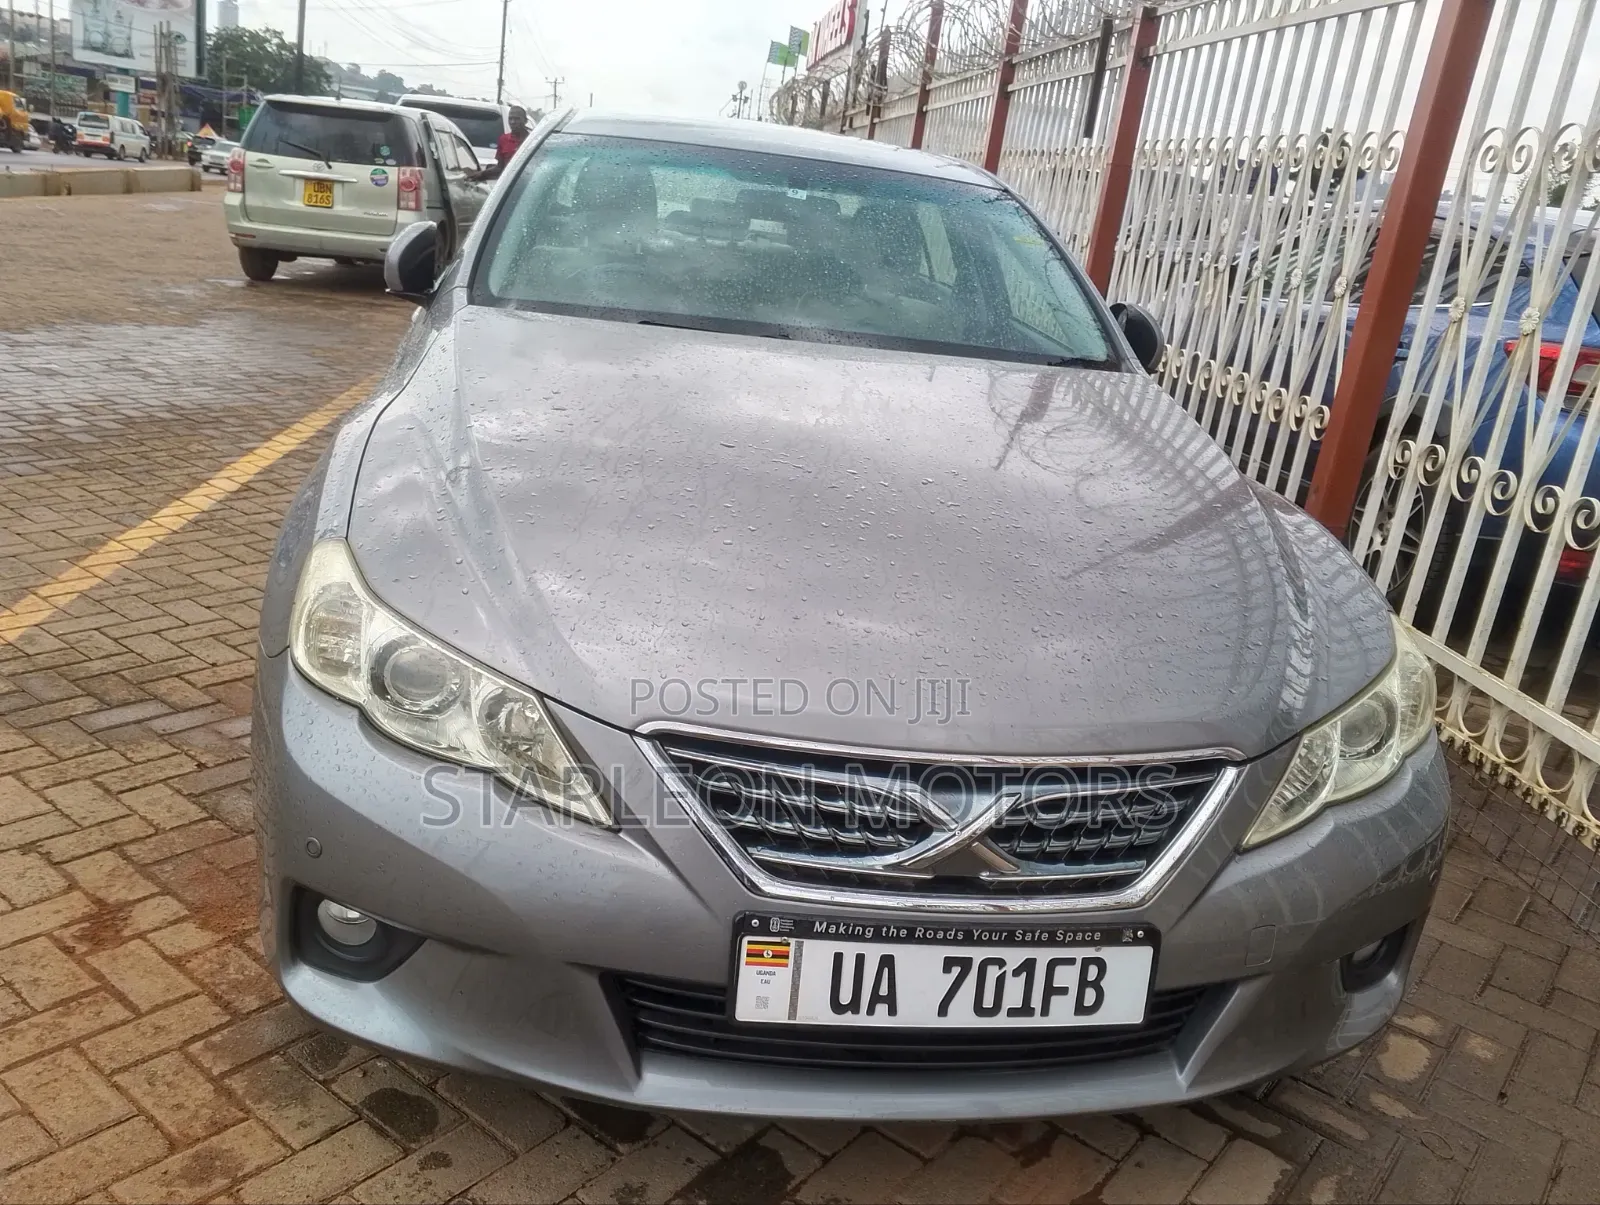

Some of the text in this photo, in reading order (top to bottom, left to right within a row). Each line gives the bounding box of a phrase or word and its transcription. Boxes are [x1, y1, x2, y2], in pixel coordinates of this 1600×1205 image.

[813, 921, 1102, 943] Making the Roads Your Safe Space
[829, 951, 1107, 1018] UA 701FB
